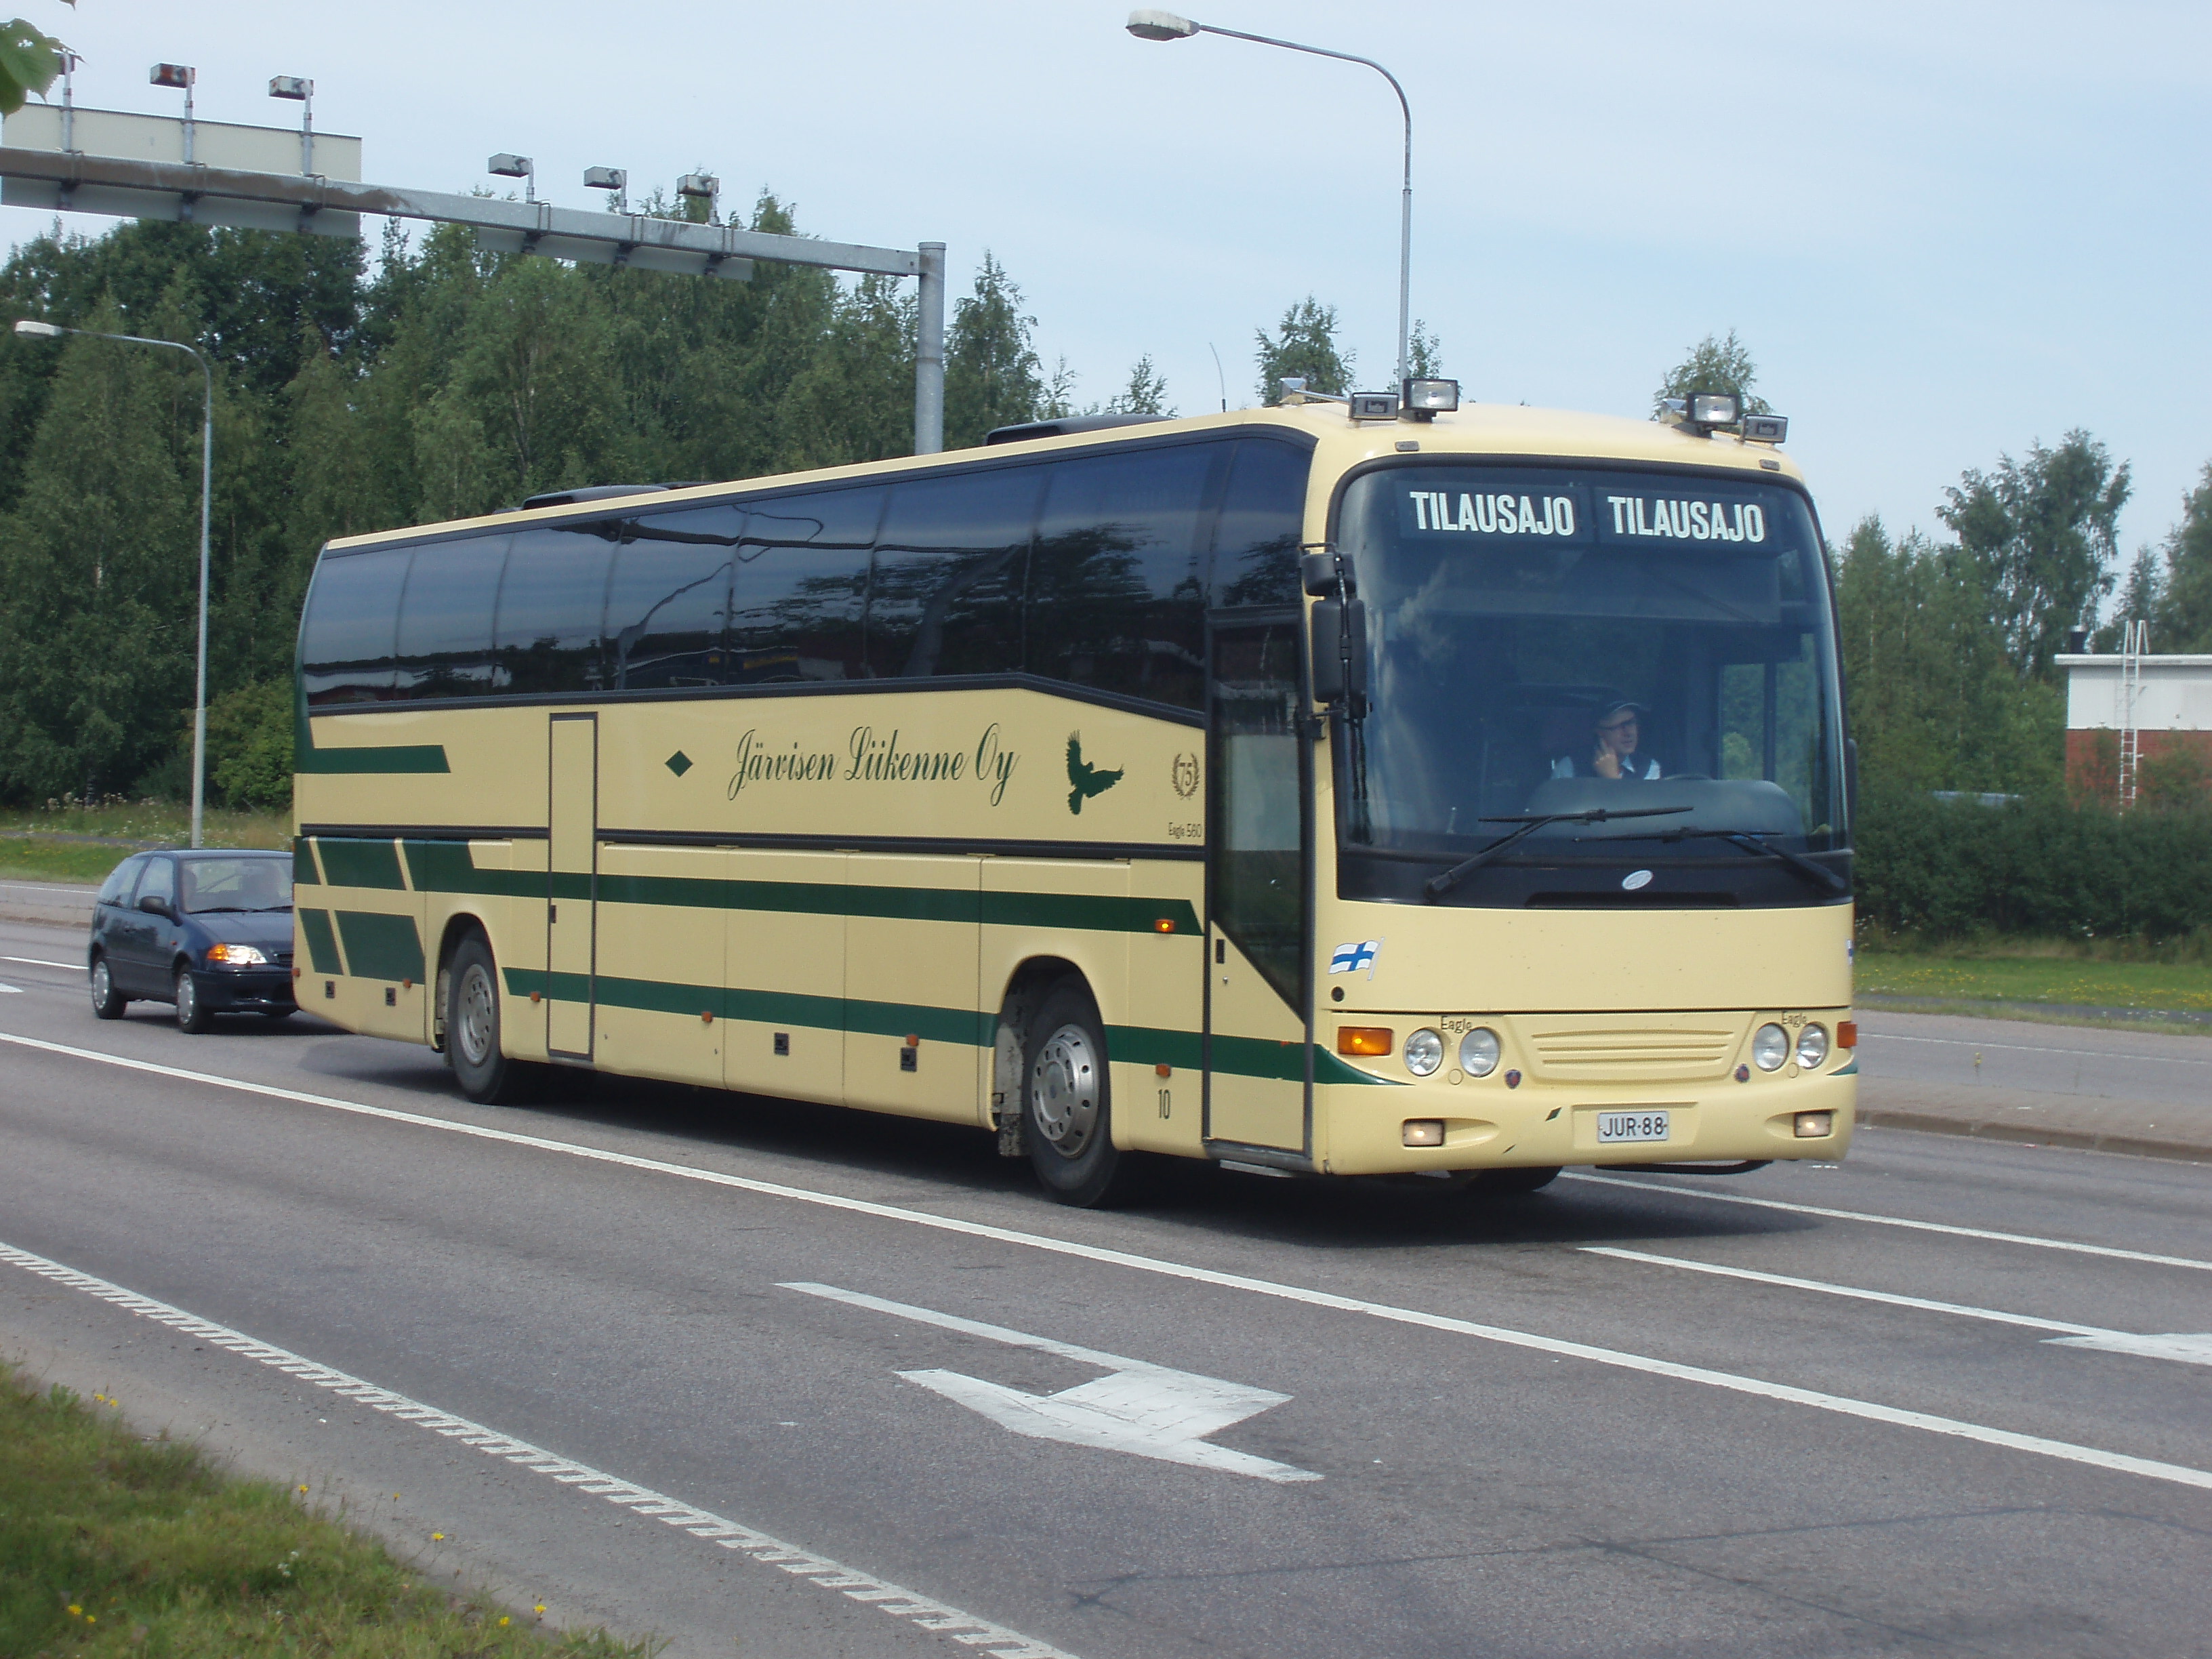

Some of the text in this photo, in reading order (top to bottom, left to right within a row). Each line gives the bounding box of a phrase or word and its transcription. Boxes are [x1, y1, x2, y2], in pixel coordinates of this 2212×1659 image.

[1410, 491, 1575, 536] TILAUSAJO
[1607, 496, 1765, 542] TILAUSAJO
[727, 722, 1021, 806] Järvisen Liikenne Oy
[1179, 762, 1193, 786] 75
[1441, 1016, 1473, 1033] Eagle
[1780, 1010, 1807, 1027] Eagle
[1158, 1089, 1170, 1119] 10
